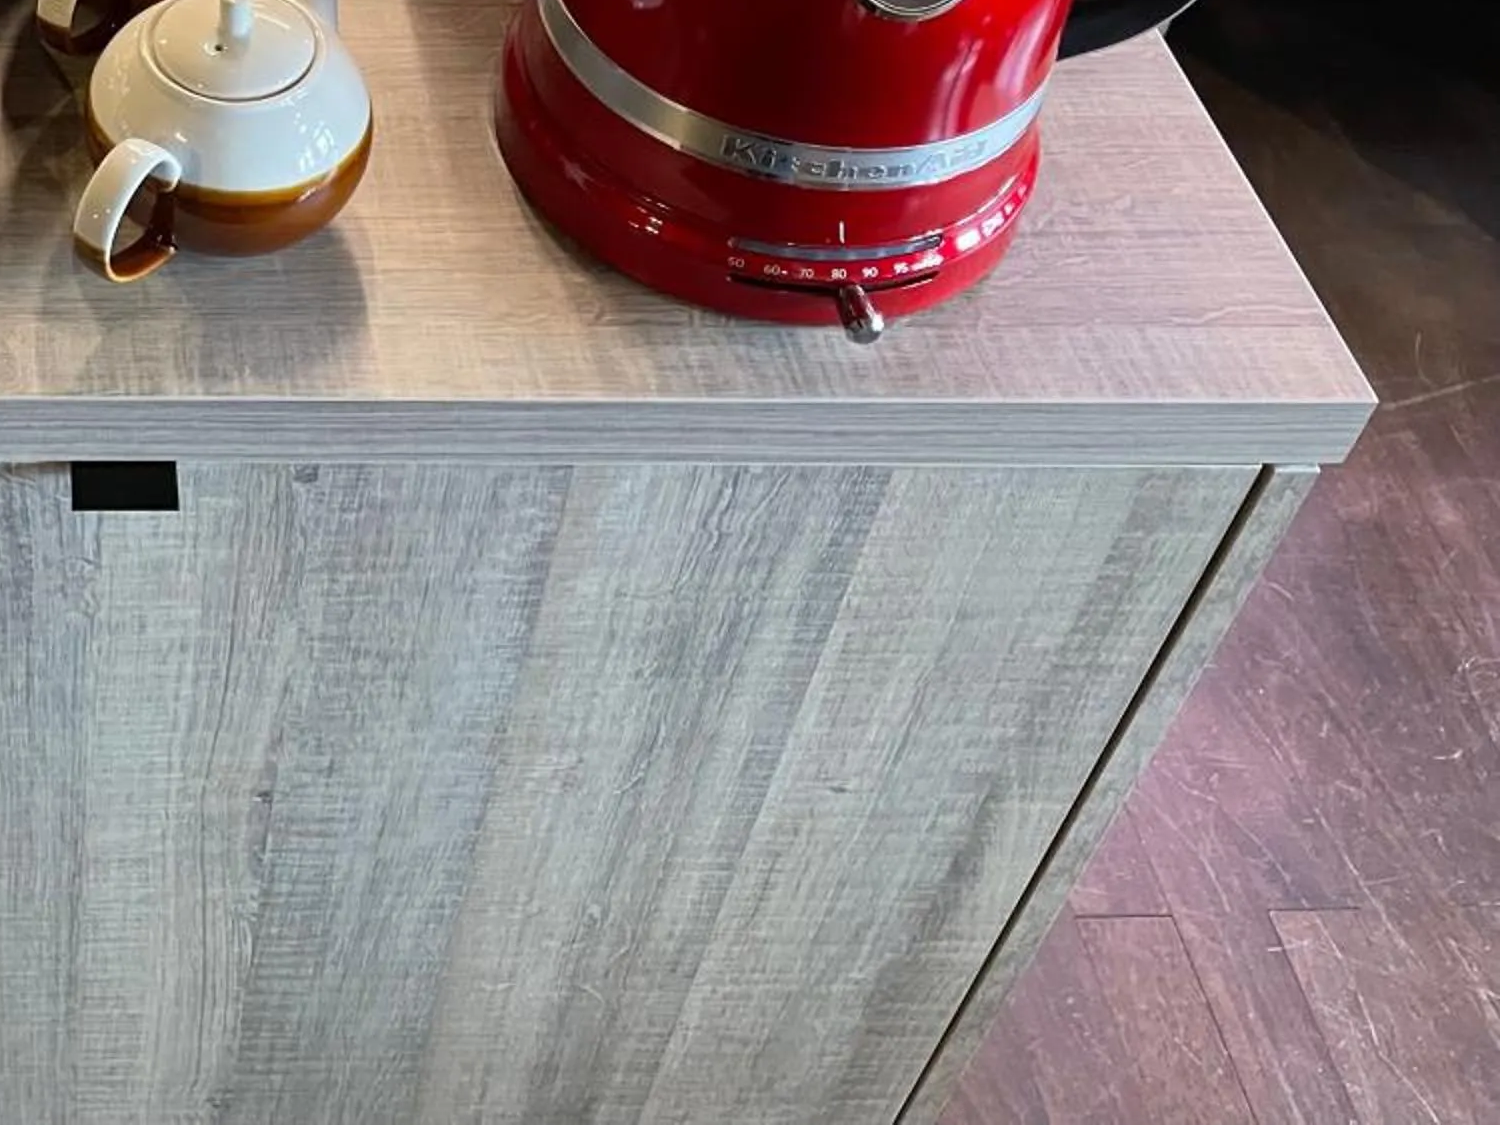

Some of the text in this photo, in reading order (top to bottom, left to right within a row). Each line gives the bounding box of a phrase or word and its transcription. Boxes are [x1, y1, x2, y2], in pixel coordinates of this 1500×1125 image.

[727, 256, 745, 268] 50
[763, 264, 781, 276] 60
[801, 268, 815, 279] 70
[831, 268, 847, 279] 80
[862, 267, 879, 279] 90
